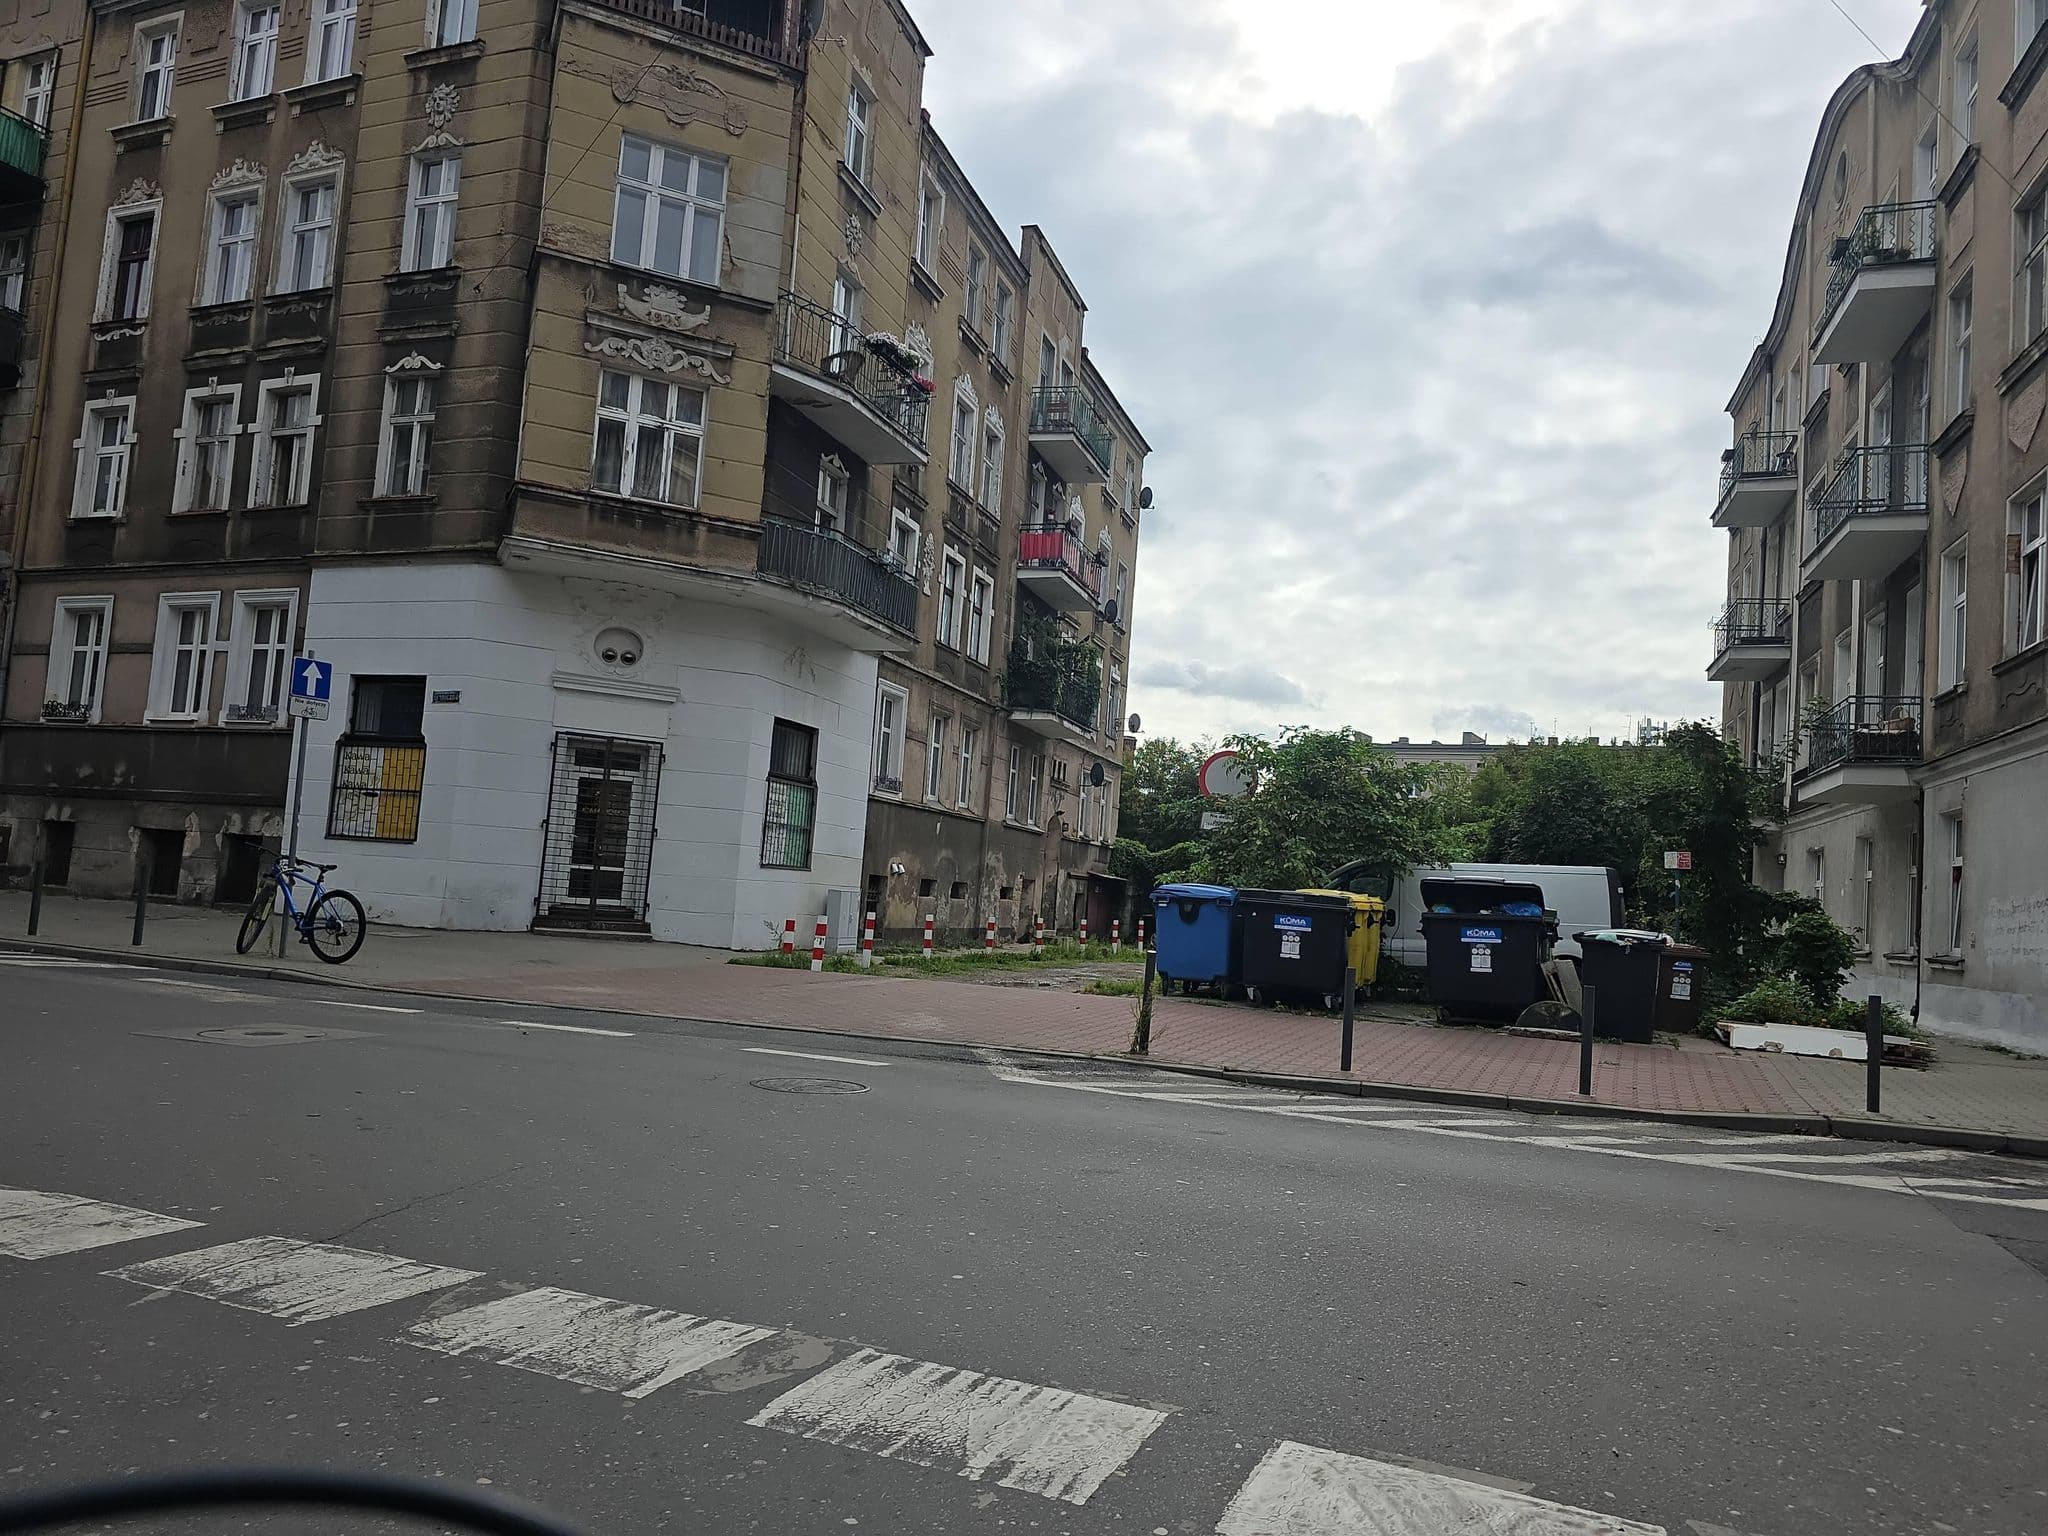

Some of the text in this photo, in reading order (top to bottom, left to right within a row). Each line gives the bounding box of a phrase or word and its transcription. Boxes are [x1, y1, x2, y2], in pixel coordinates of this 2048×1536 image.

[306, 699, 327, 708] dotyczy
[1279, 916, 1307, 925] KOMA
[1466, 929, 1496, 938] KOMA
